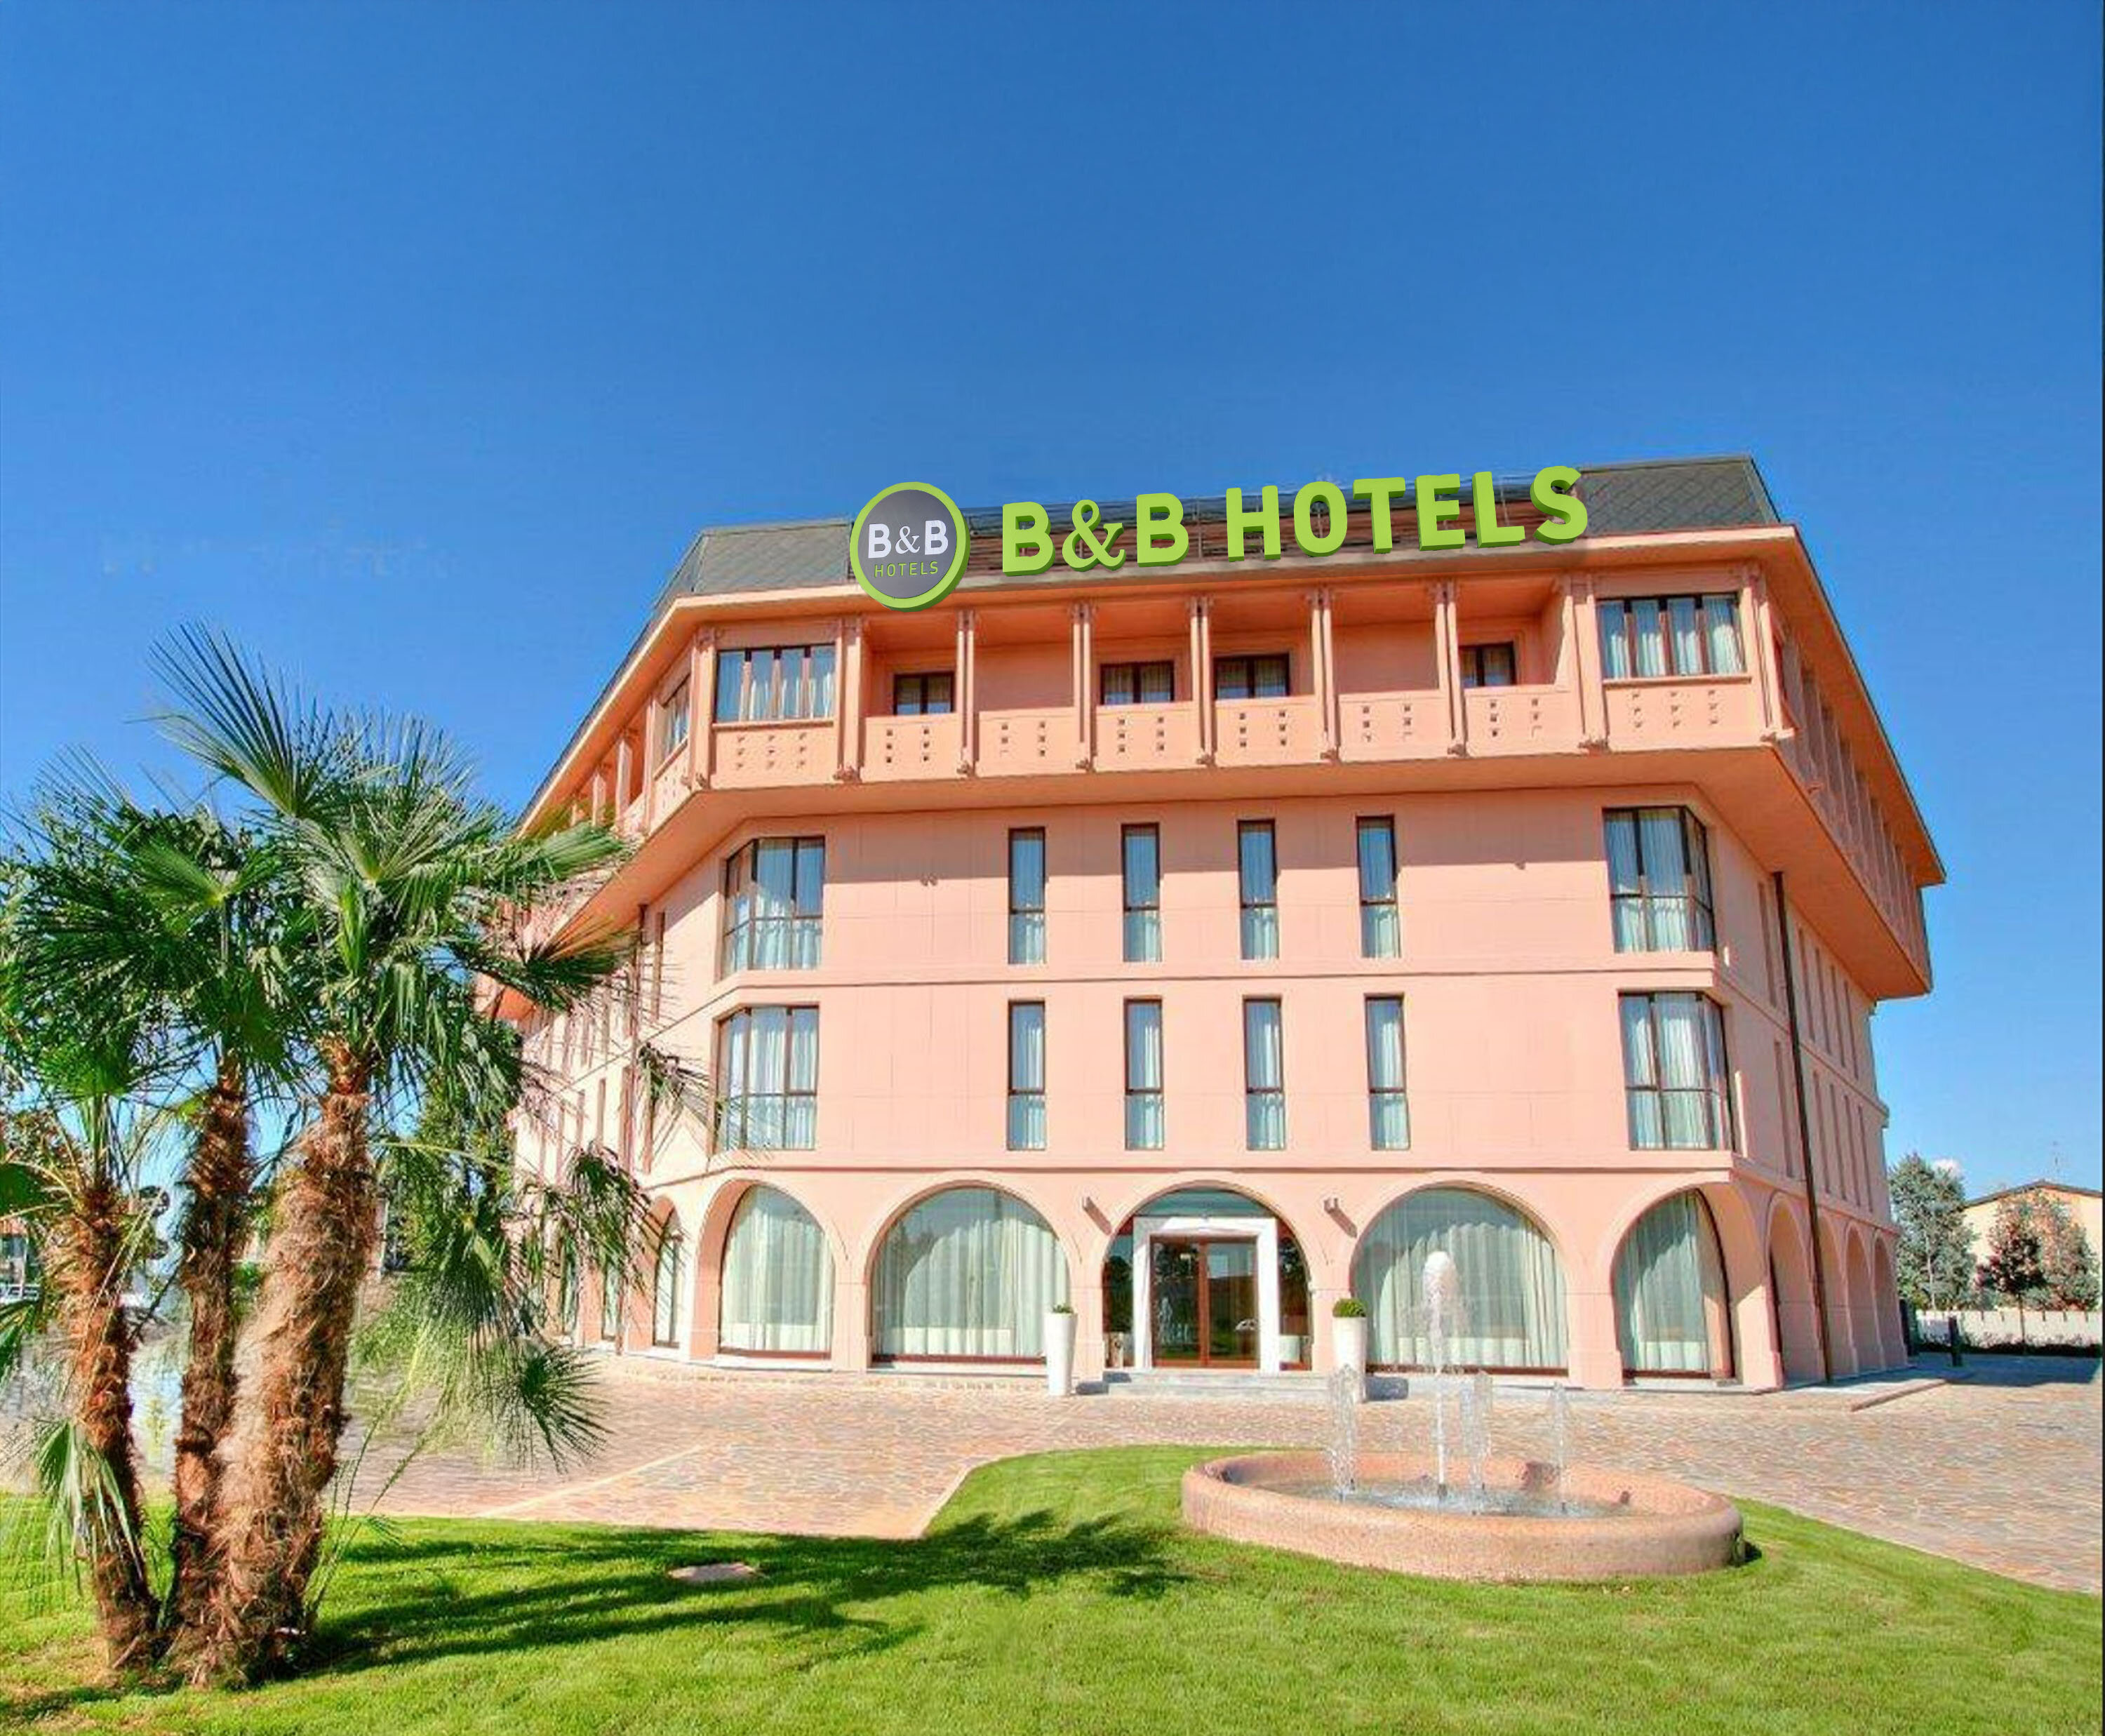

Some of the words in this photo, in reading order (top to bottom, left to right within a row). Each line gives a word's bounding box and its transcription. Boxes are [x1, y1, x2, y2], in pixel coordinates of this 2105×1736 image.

[868, 520, 949, 559] B&B
[1002, 493, 1191, 576] B&B
[1226, 466, 1588, 561] HOTELS
[874, 561, 939, 578] HOTELS
